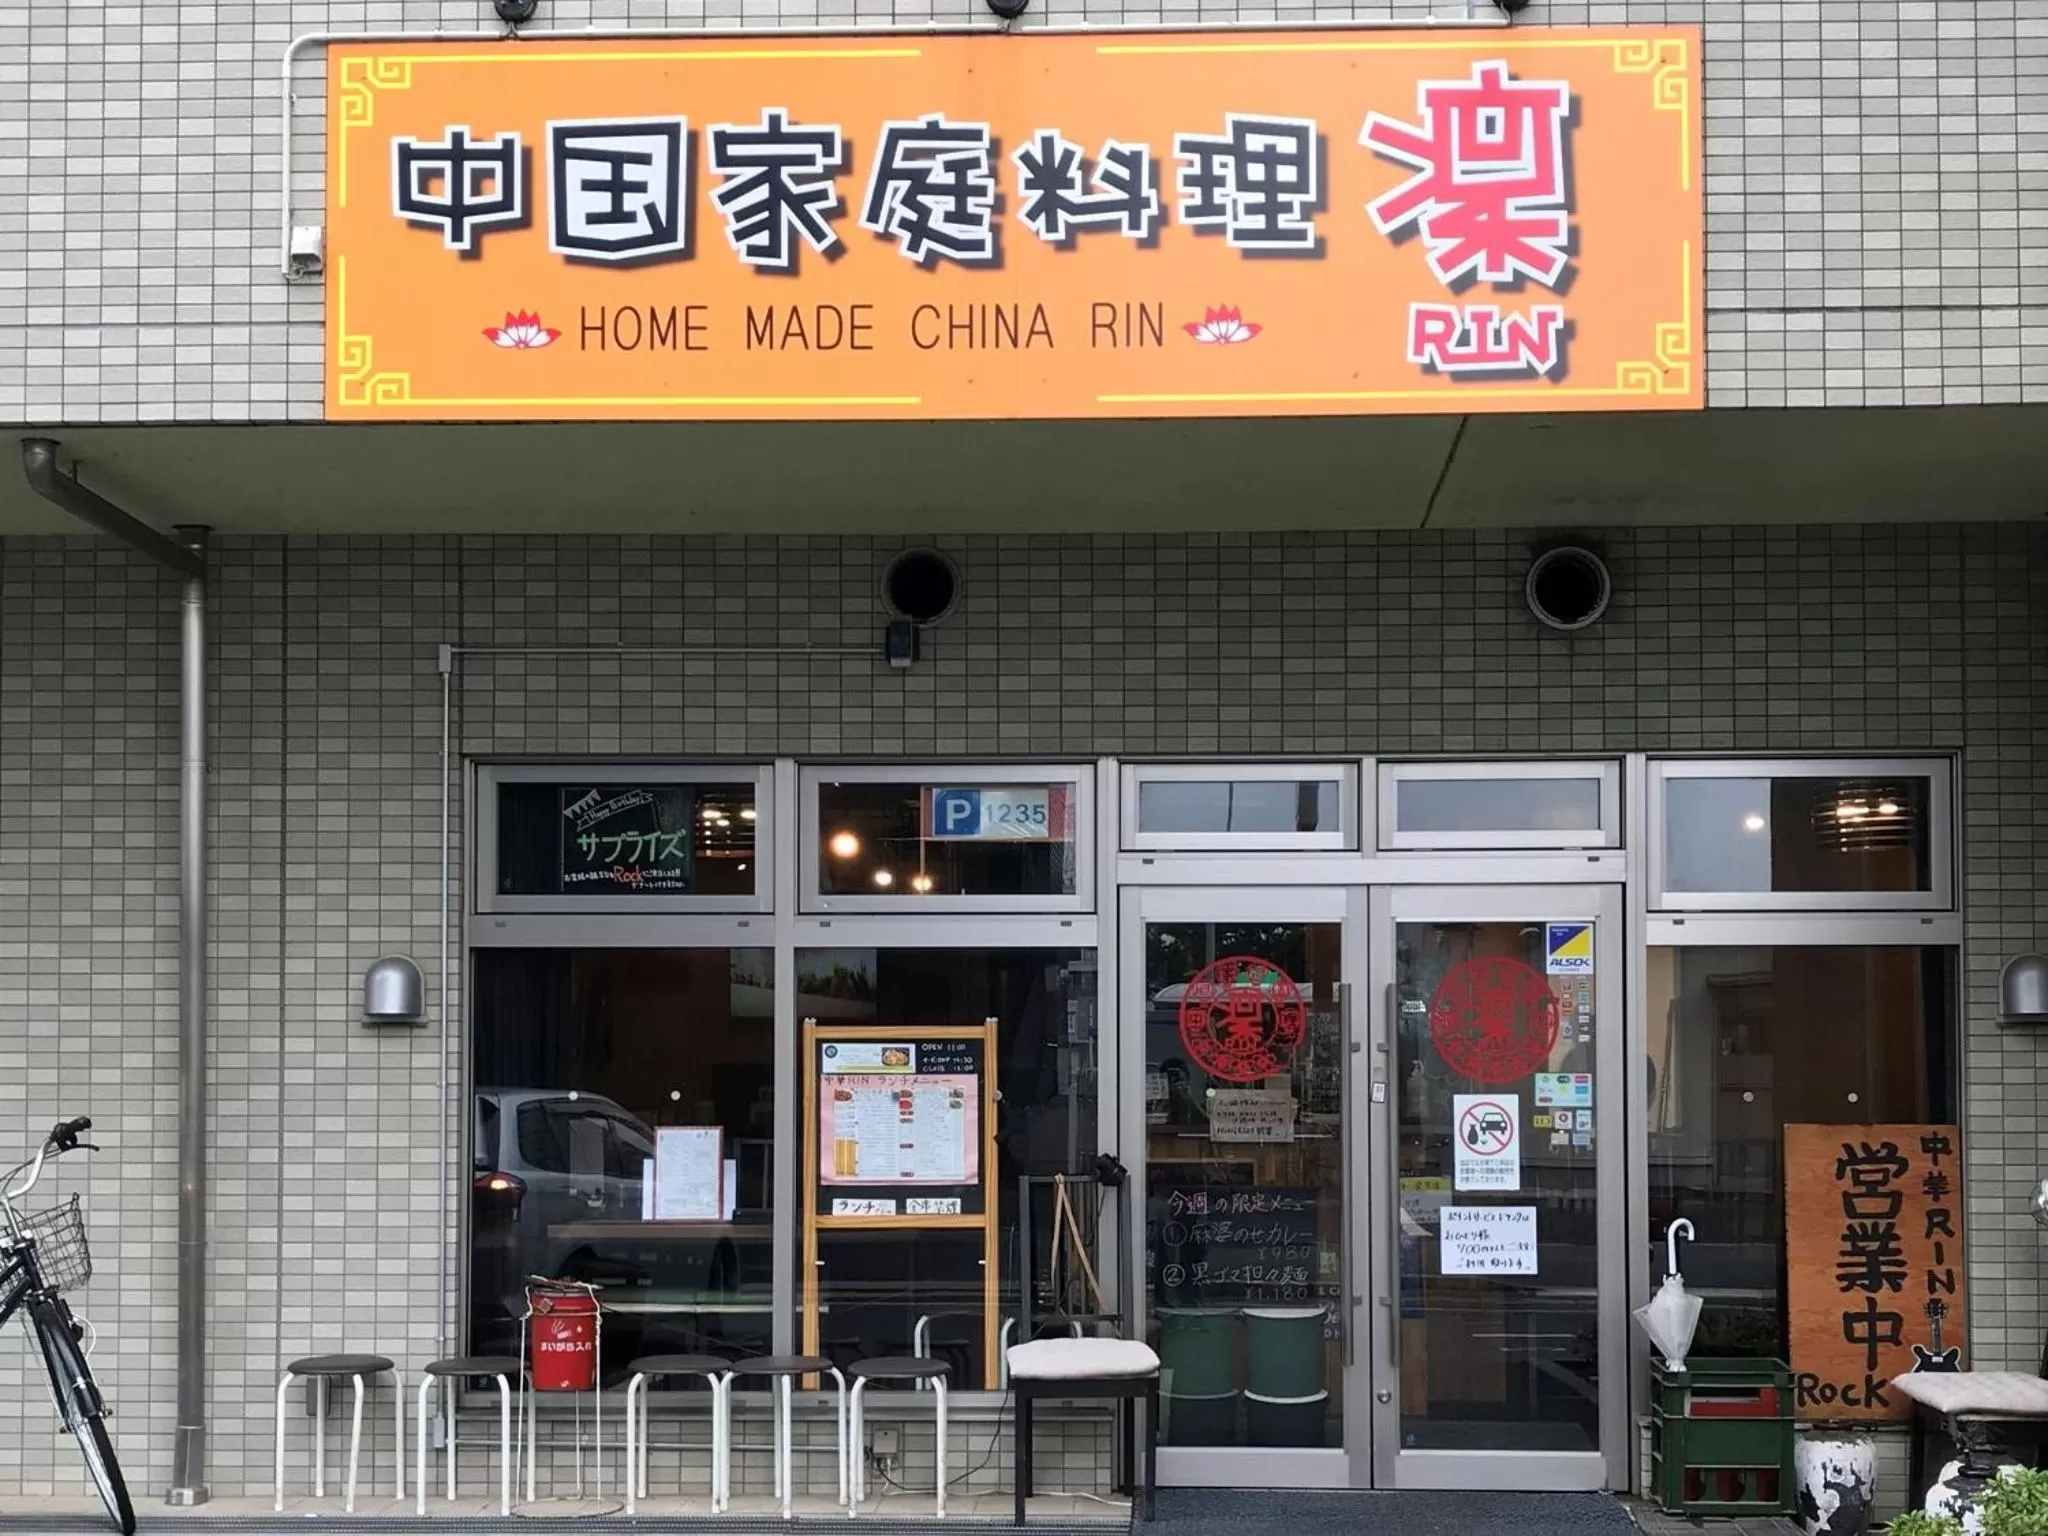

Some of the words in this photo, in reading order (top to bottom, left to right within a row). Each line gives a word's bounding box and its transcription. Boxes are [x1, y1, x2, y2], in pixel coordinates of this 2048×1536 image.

[391, 107, 1317, 267] 中国家庭料理
[579, 304, 709, 351] HOME
[746, 304, 874, 350] MADE
[911, 303, 1053, 350] CHINA
[1091, 302, 1164, 348] RIN
[1407, 302, 1564, 374] RIN
[946, 799, 971, 830] P
[986, 803, 1046, 825] 1235
[576, 827, 687, 863] サプライズ
[1549, 957, 1590, 967] ALSOK
[1835, 1141, 1909, 1372] 営業中
